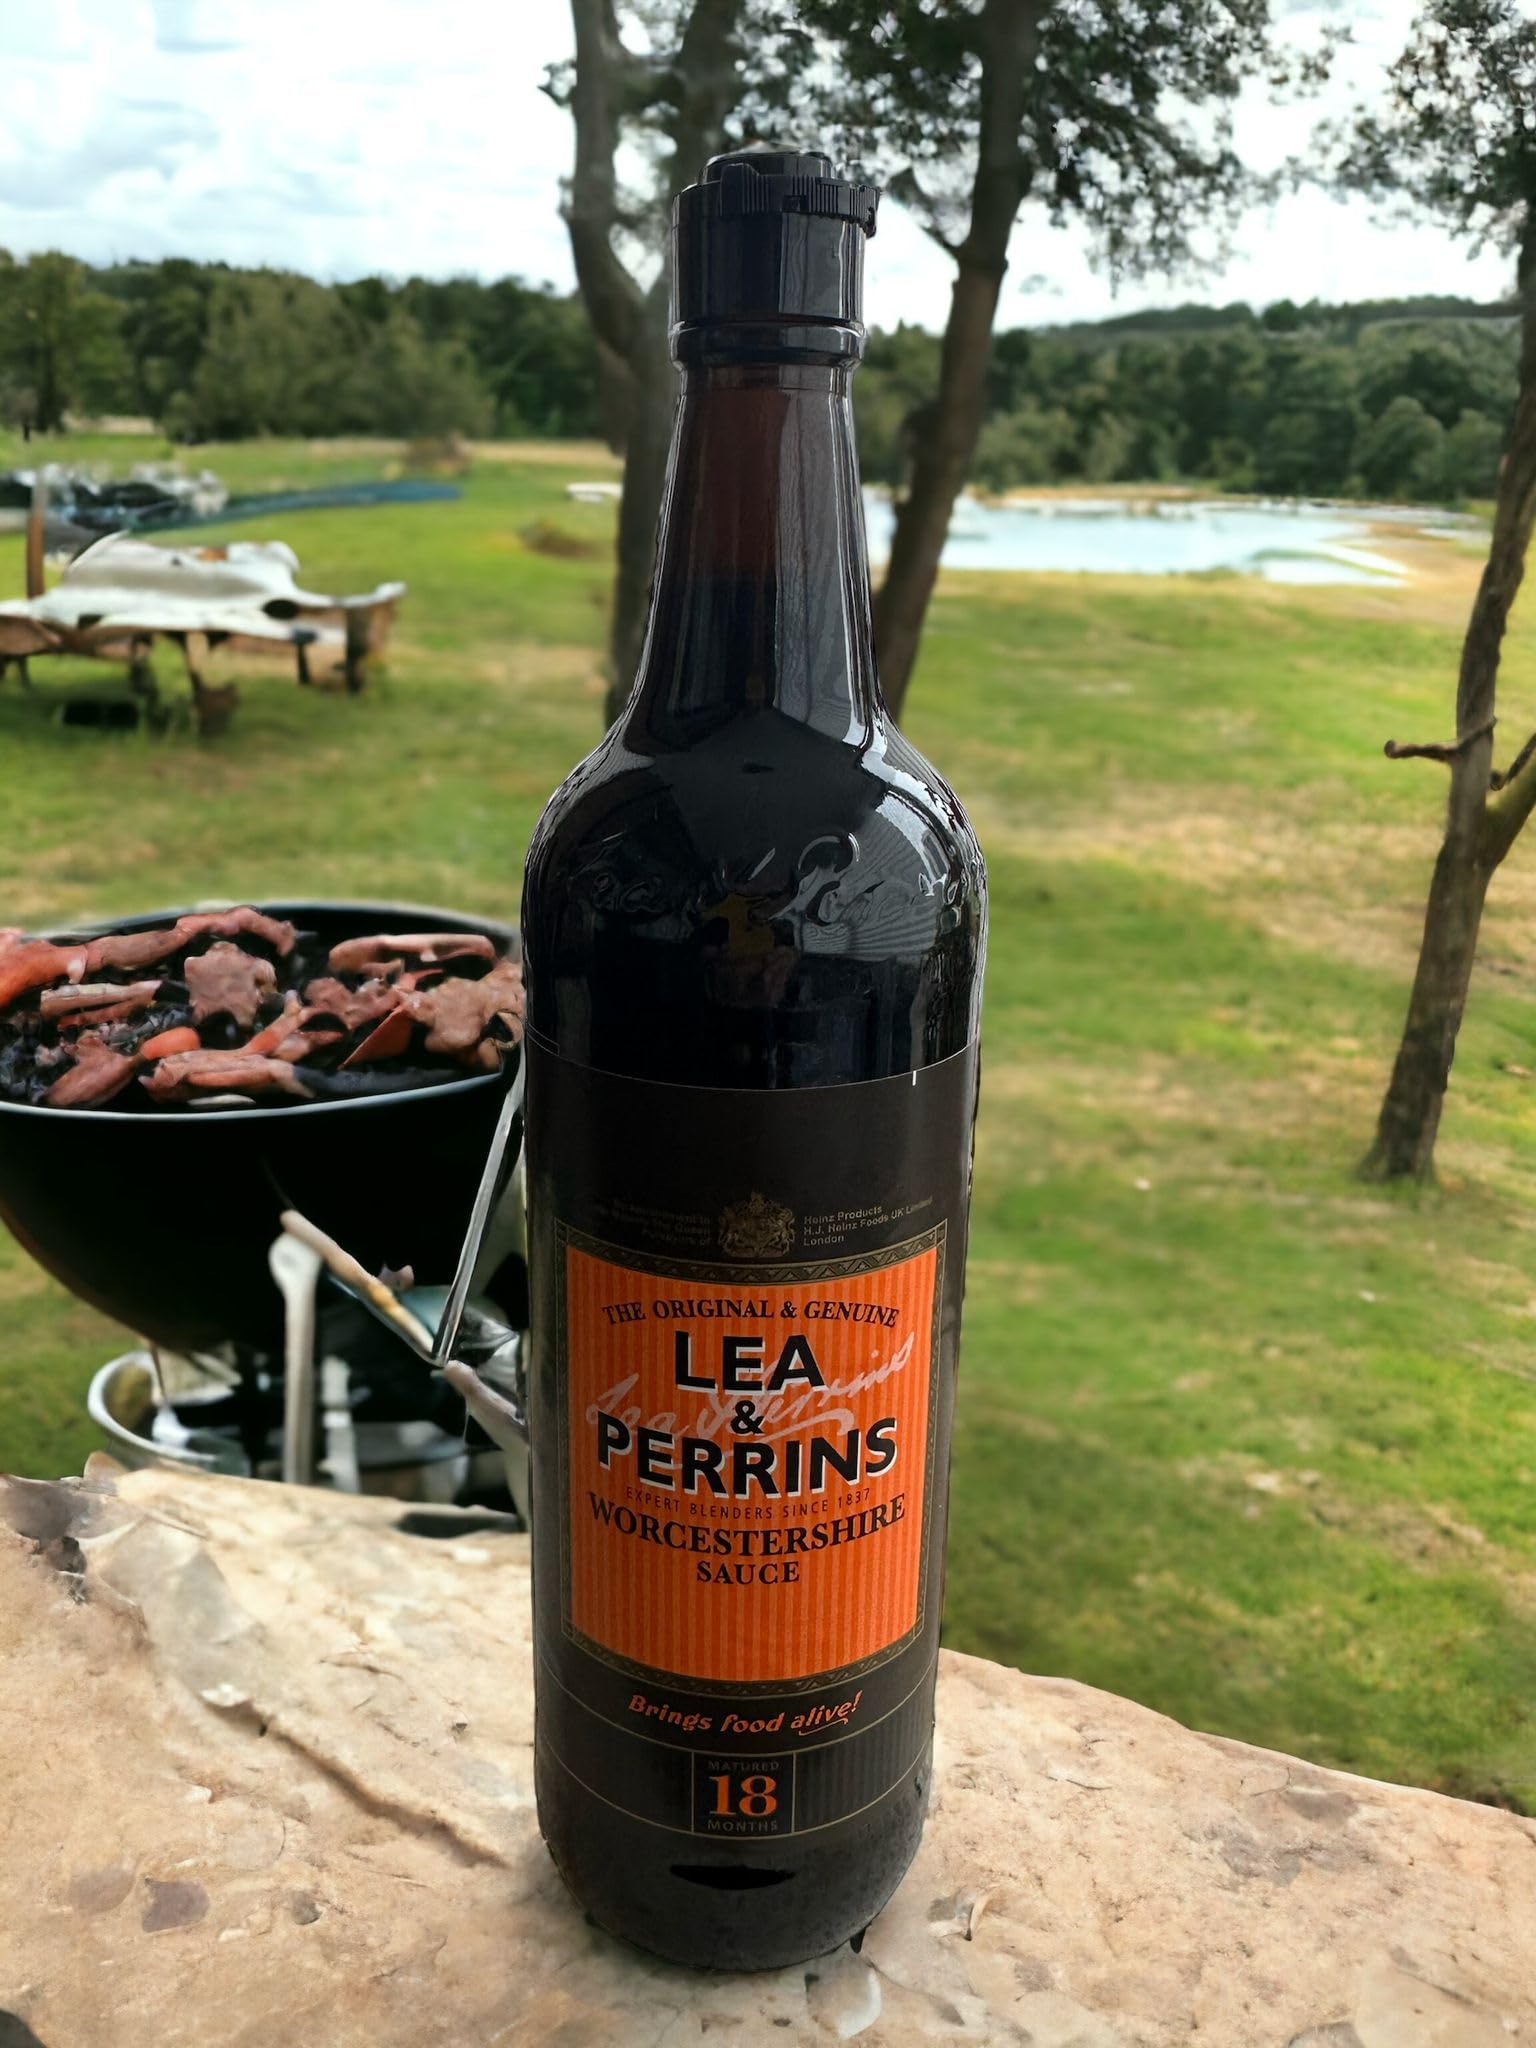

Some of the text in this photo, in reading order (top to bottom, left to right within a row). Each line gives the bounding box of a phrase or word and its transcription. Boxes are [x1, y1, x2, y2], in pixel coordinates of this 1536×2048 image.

[836, 1206, 883, 1221] Products
[859, 1214, 890, 1228] Foods
[803, 1234, 845, 1247] London
[603, 1299, 899, 1328] THE ORIGINAL & GENUINE
[675, 1330, 829, 1396] LEA
[730, 1400, 766, 1436] &
[598, 1417, 898, 1500] PERRINS
[626, 1486, 871, 1520] EXPERT BLENDERS SINCE 1837
[589, 1492, 906, 1557] WORCESTERSHIRE
[696, 1561, 800, 1585] SAUCE
[628, 1690, 863, 1733] Brings food alive!
[707, 1760, 780, 1772] MATURED
[708, 1774, 777, 1817] 18
[707, 1819, 778, 1832] MONTHS
